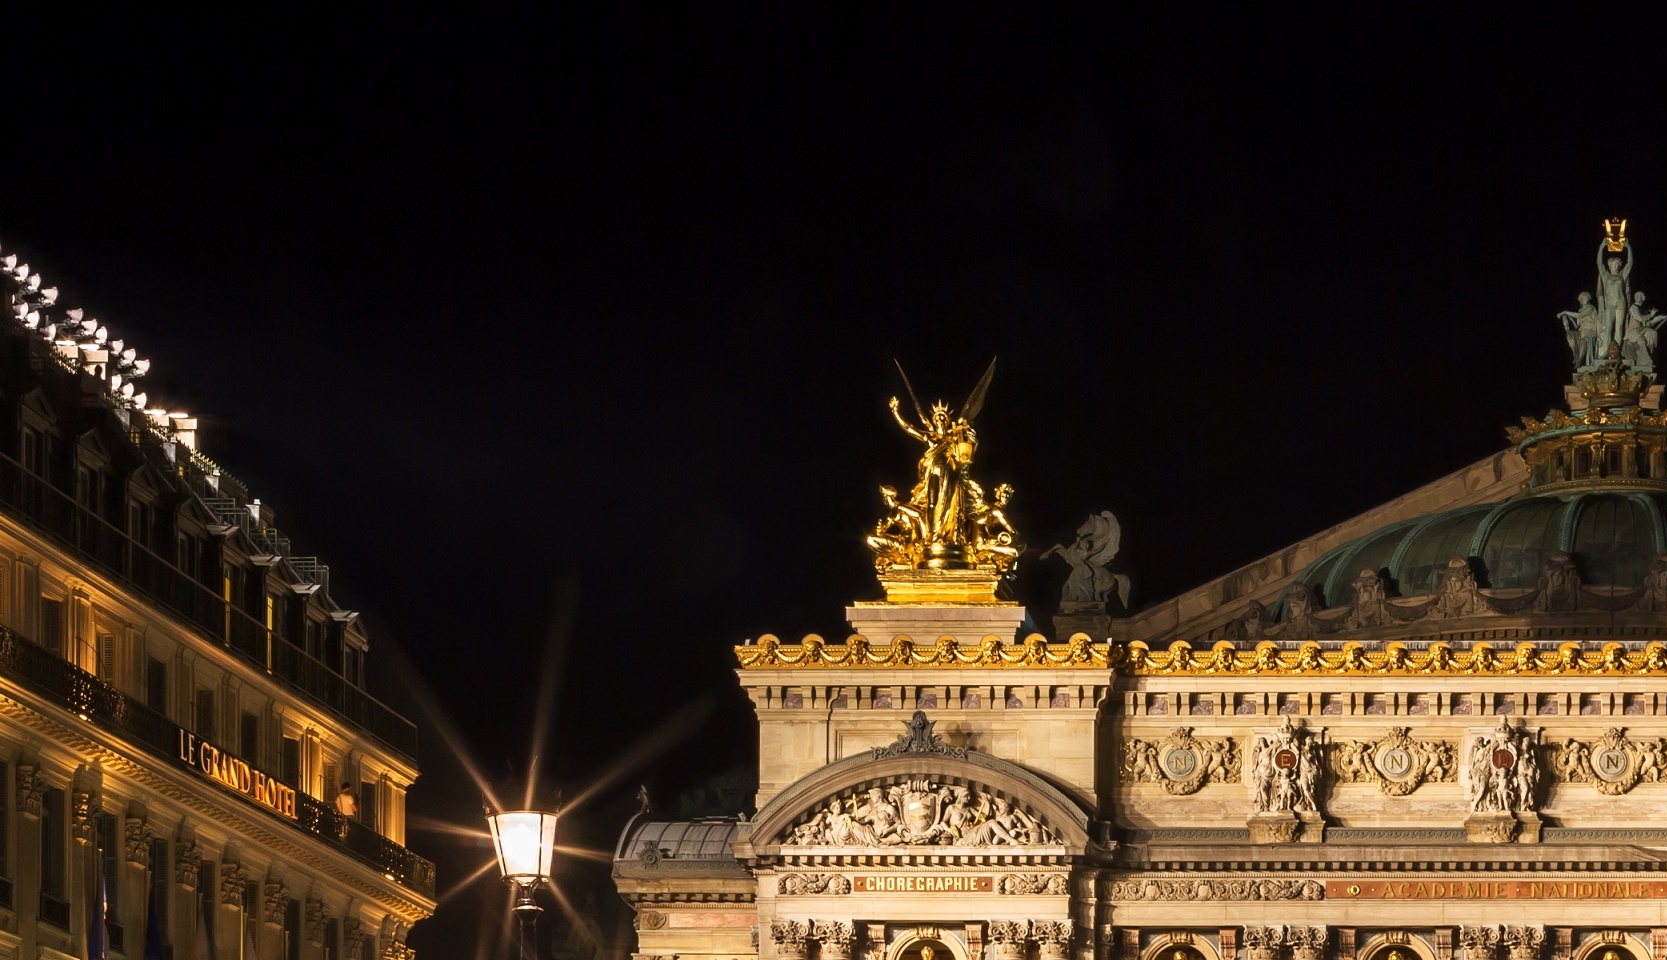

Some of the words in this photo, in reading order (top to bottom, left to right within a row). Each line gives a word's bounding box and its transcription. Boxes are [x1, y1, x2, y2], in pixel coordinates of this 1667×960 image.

[1174, 755, 1187, 769] N
[1280, 753, 1291, 767] E
[1390, 755, 1403, 769] N
[1606, 755, 1619, 769] N
[180, 728, 195, 766] LE
[201, 741, 251, 793] GRAND
[252, 769, 298, 819] HOTEL
[865, 877, 979, 891] CHOREGRAPHIE
[1381, 882, 1509, 899] ACADEMIE
[1530, 882, 1652, 899] NATIONALE
